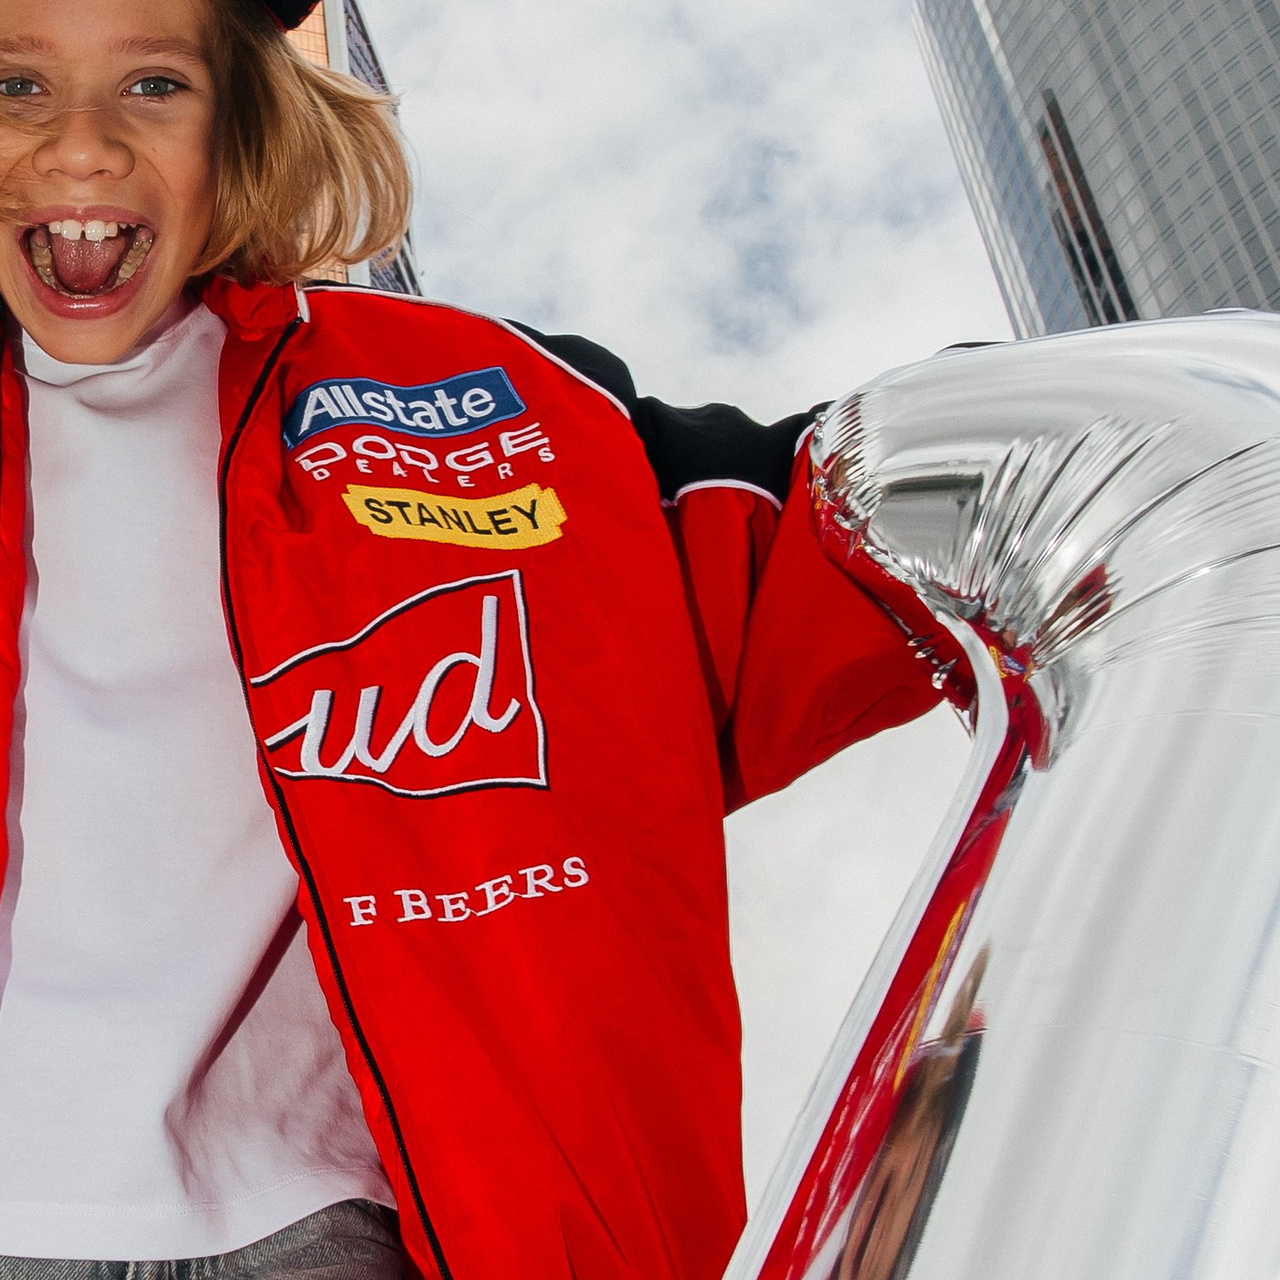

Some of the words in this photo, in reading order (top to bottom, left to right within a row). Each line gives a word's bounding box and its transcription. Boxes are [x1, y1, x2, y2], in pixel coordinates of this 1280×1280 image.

[297, 384, 496, 436] Allstate
[295, 422, 550, 472] DODGE
[310, 446, 556, 487] DEALERS
[364, 498, 541, 536] STANLEY
[393, 856, 591, 922] BEERS
